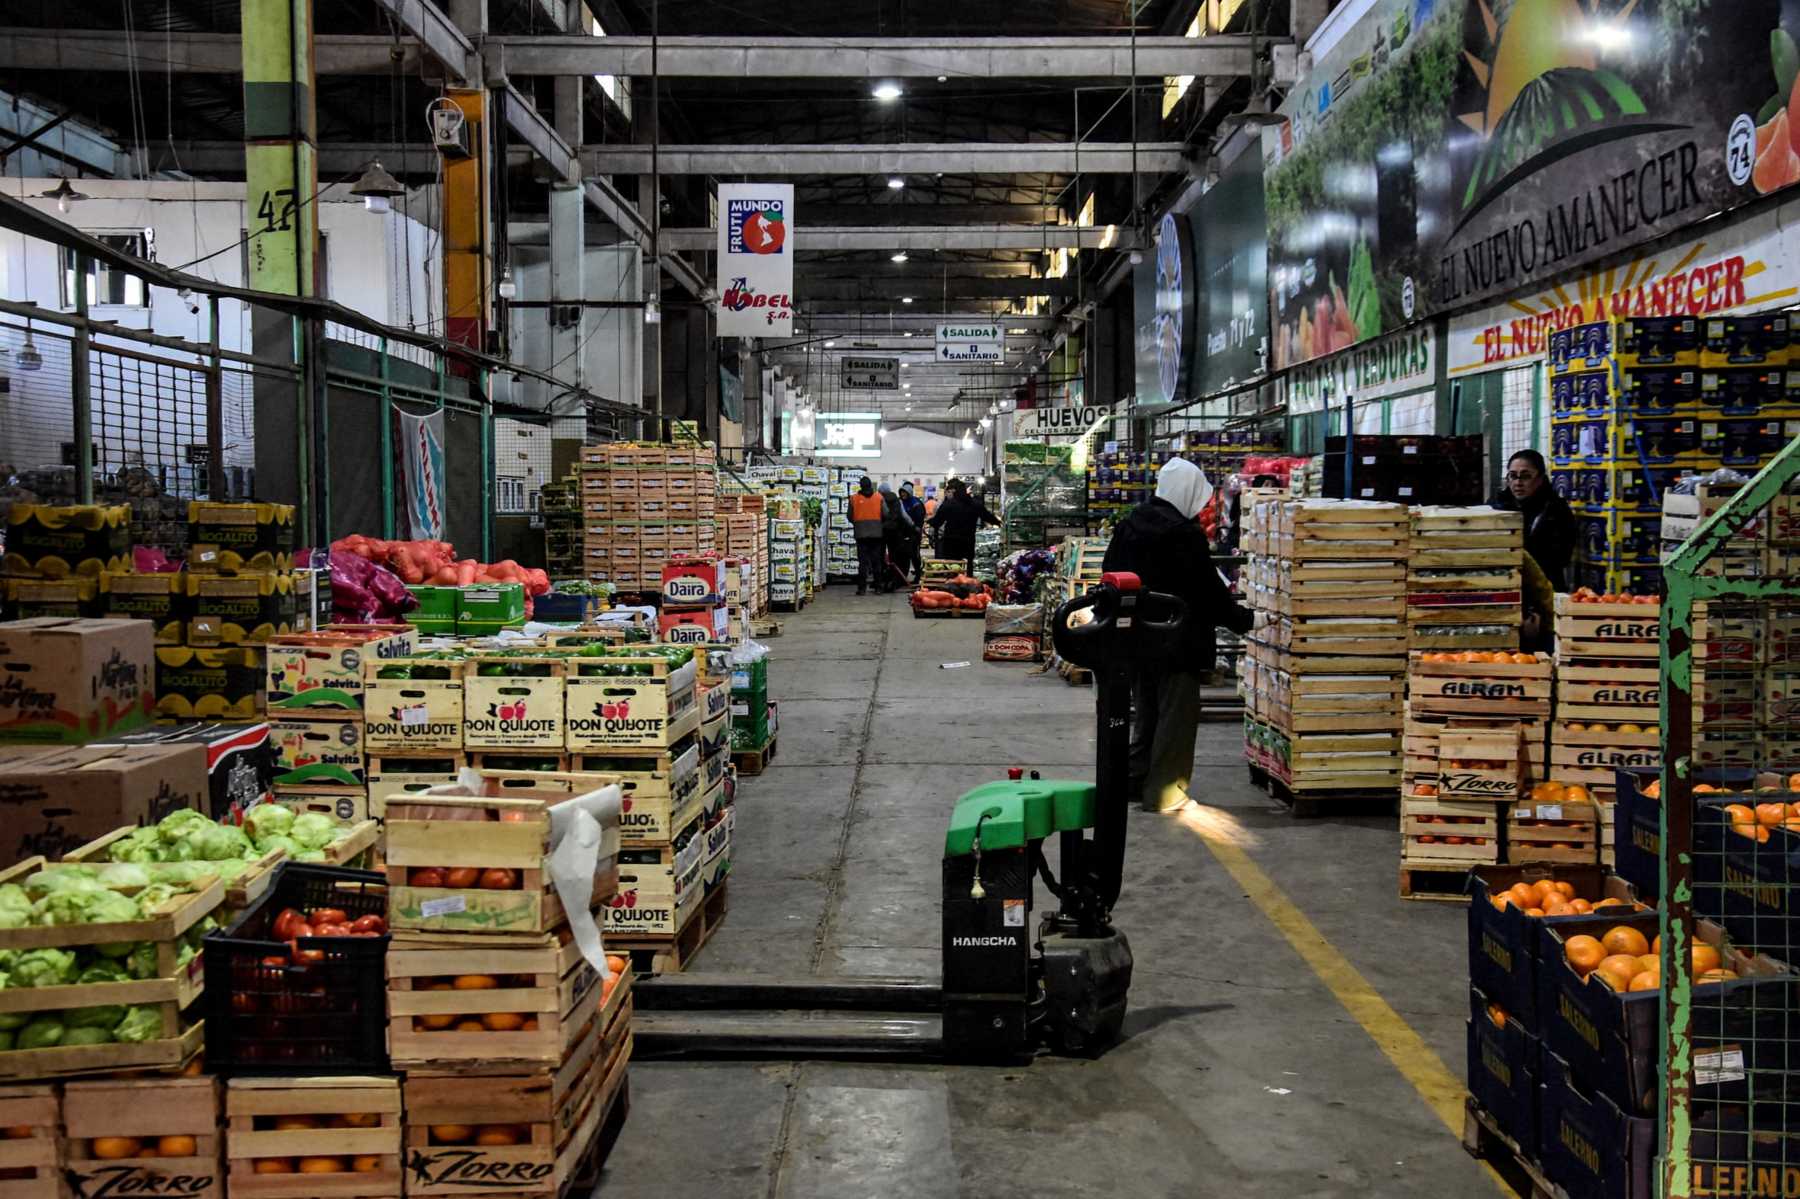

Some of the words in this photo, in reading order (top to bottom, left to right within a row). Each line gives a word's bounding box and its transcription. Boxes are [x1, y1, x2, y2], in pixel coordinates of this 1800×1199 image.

[1731, 142, 1750, 173] 74
[258, 190, 297, 232] 47
[731, 201, 782, 213] MUNDO
[1441, 257, 1460, 304] EL
[1462, 219, 1537, 297] NUEVO
[1542, 141, 1703, 266] AMANECER
[731, 212, 743, 253] FRUTI
[1484, 327, 1504, 364] EL
[1511, 303, 1584, 356] NUEVO
[1593, 256, 1746, 320] AMANECER
[949, 328, 990, 337] SALIDA
[949, 352, 999, 360] SANITARIO
[1354, 327, 1430, 392] VERDURAS
[853, 361, 887, 369] SALIDA
[1037, 402, 1109, 428] HUEVOS
[670, 581, 705, 596] Daira
[671, 628, 706, 642] Daira
[1595, 622, 1660, 638] ALRA
[323, 678, 361, 689] Salvita
[1593, 688, 1660, 703] ALRA
[366, 723, 397, 735] DON
[400, 723, 457, 737] QUIJOTE
[498, 720, 556, 734] QUIJOTE
[569, 719, 602, 731] DON
[604, 719, 663, 733] QUIJOTE
[321, 753, 360, 764] Salvita
[612, 909, 669, 923] QUIJOTE
[953, 937, 1017, 946] HANGCHA
[423, 1151, 554, 1187] ZORRO
[90, 1166, 214, 1199] ZORRO
